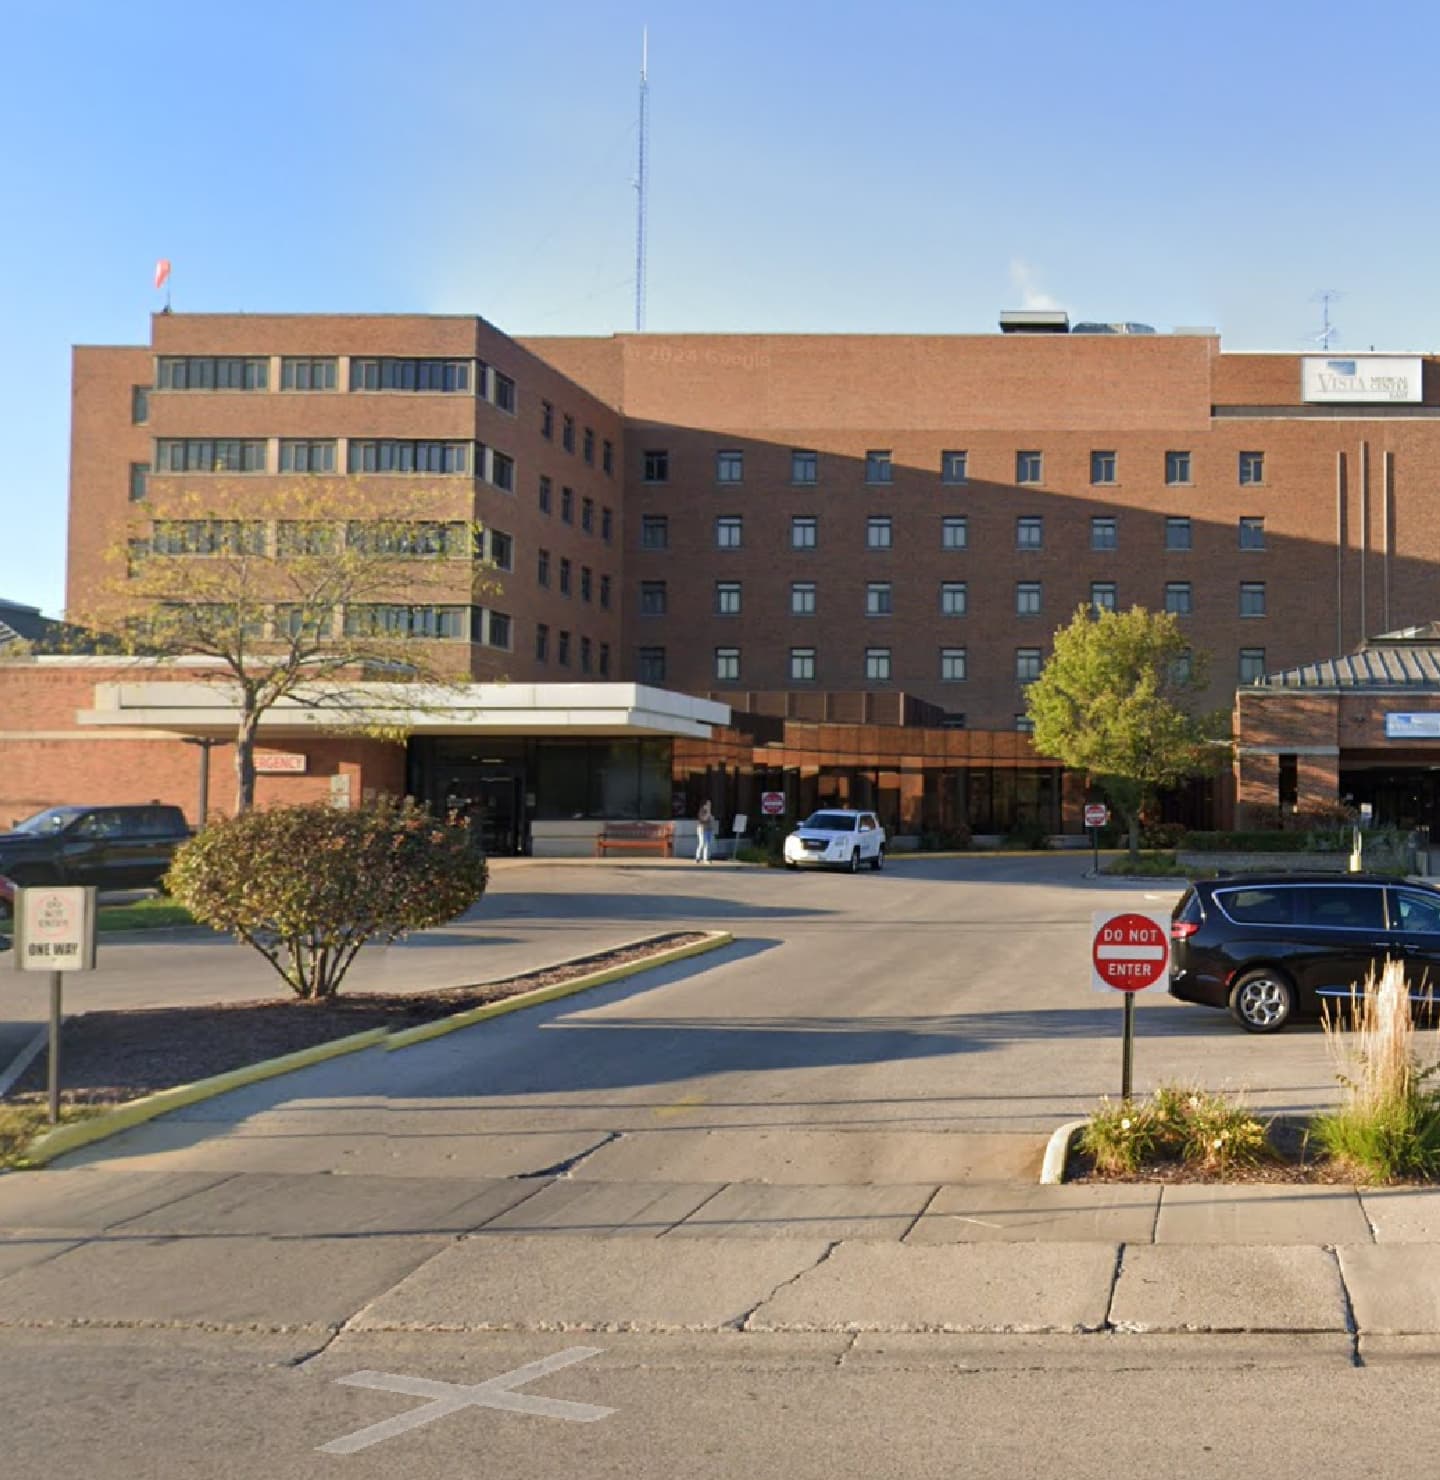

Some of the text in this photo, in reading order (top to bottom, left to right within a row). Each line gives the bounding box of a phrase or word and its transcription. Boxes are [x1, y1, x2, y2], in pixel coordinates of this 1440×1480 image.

[1317, 373, 1366, 392] VISTA
[1104, 930, 1158, 942] DO NOT
[28, 943, 78, 956] ONE WAY
[1108, 963, 1151, 976] ENTER
